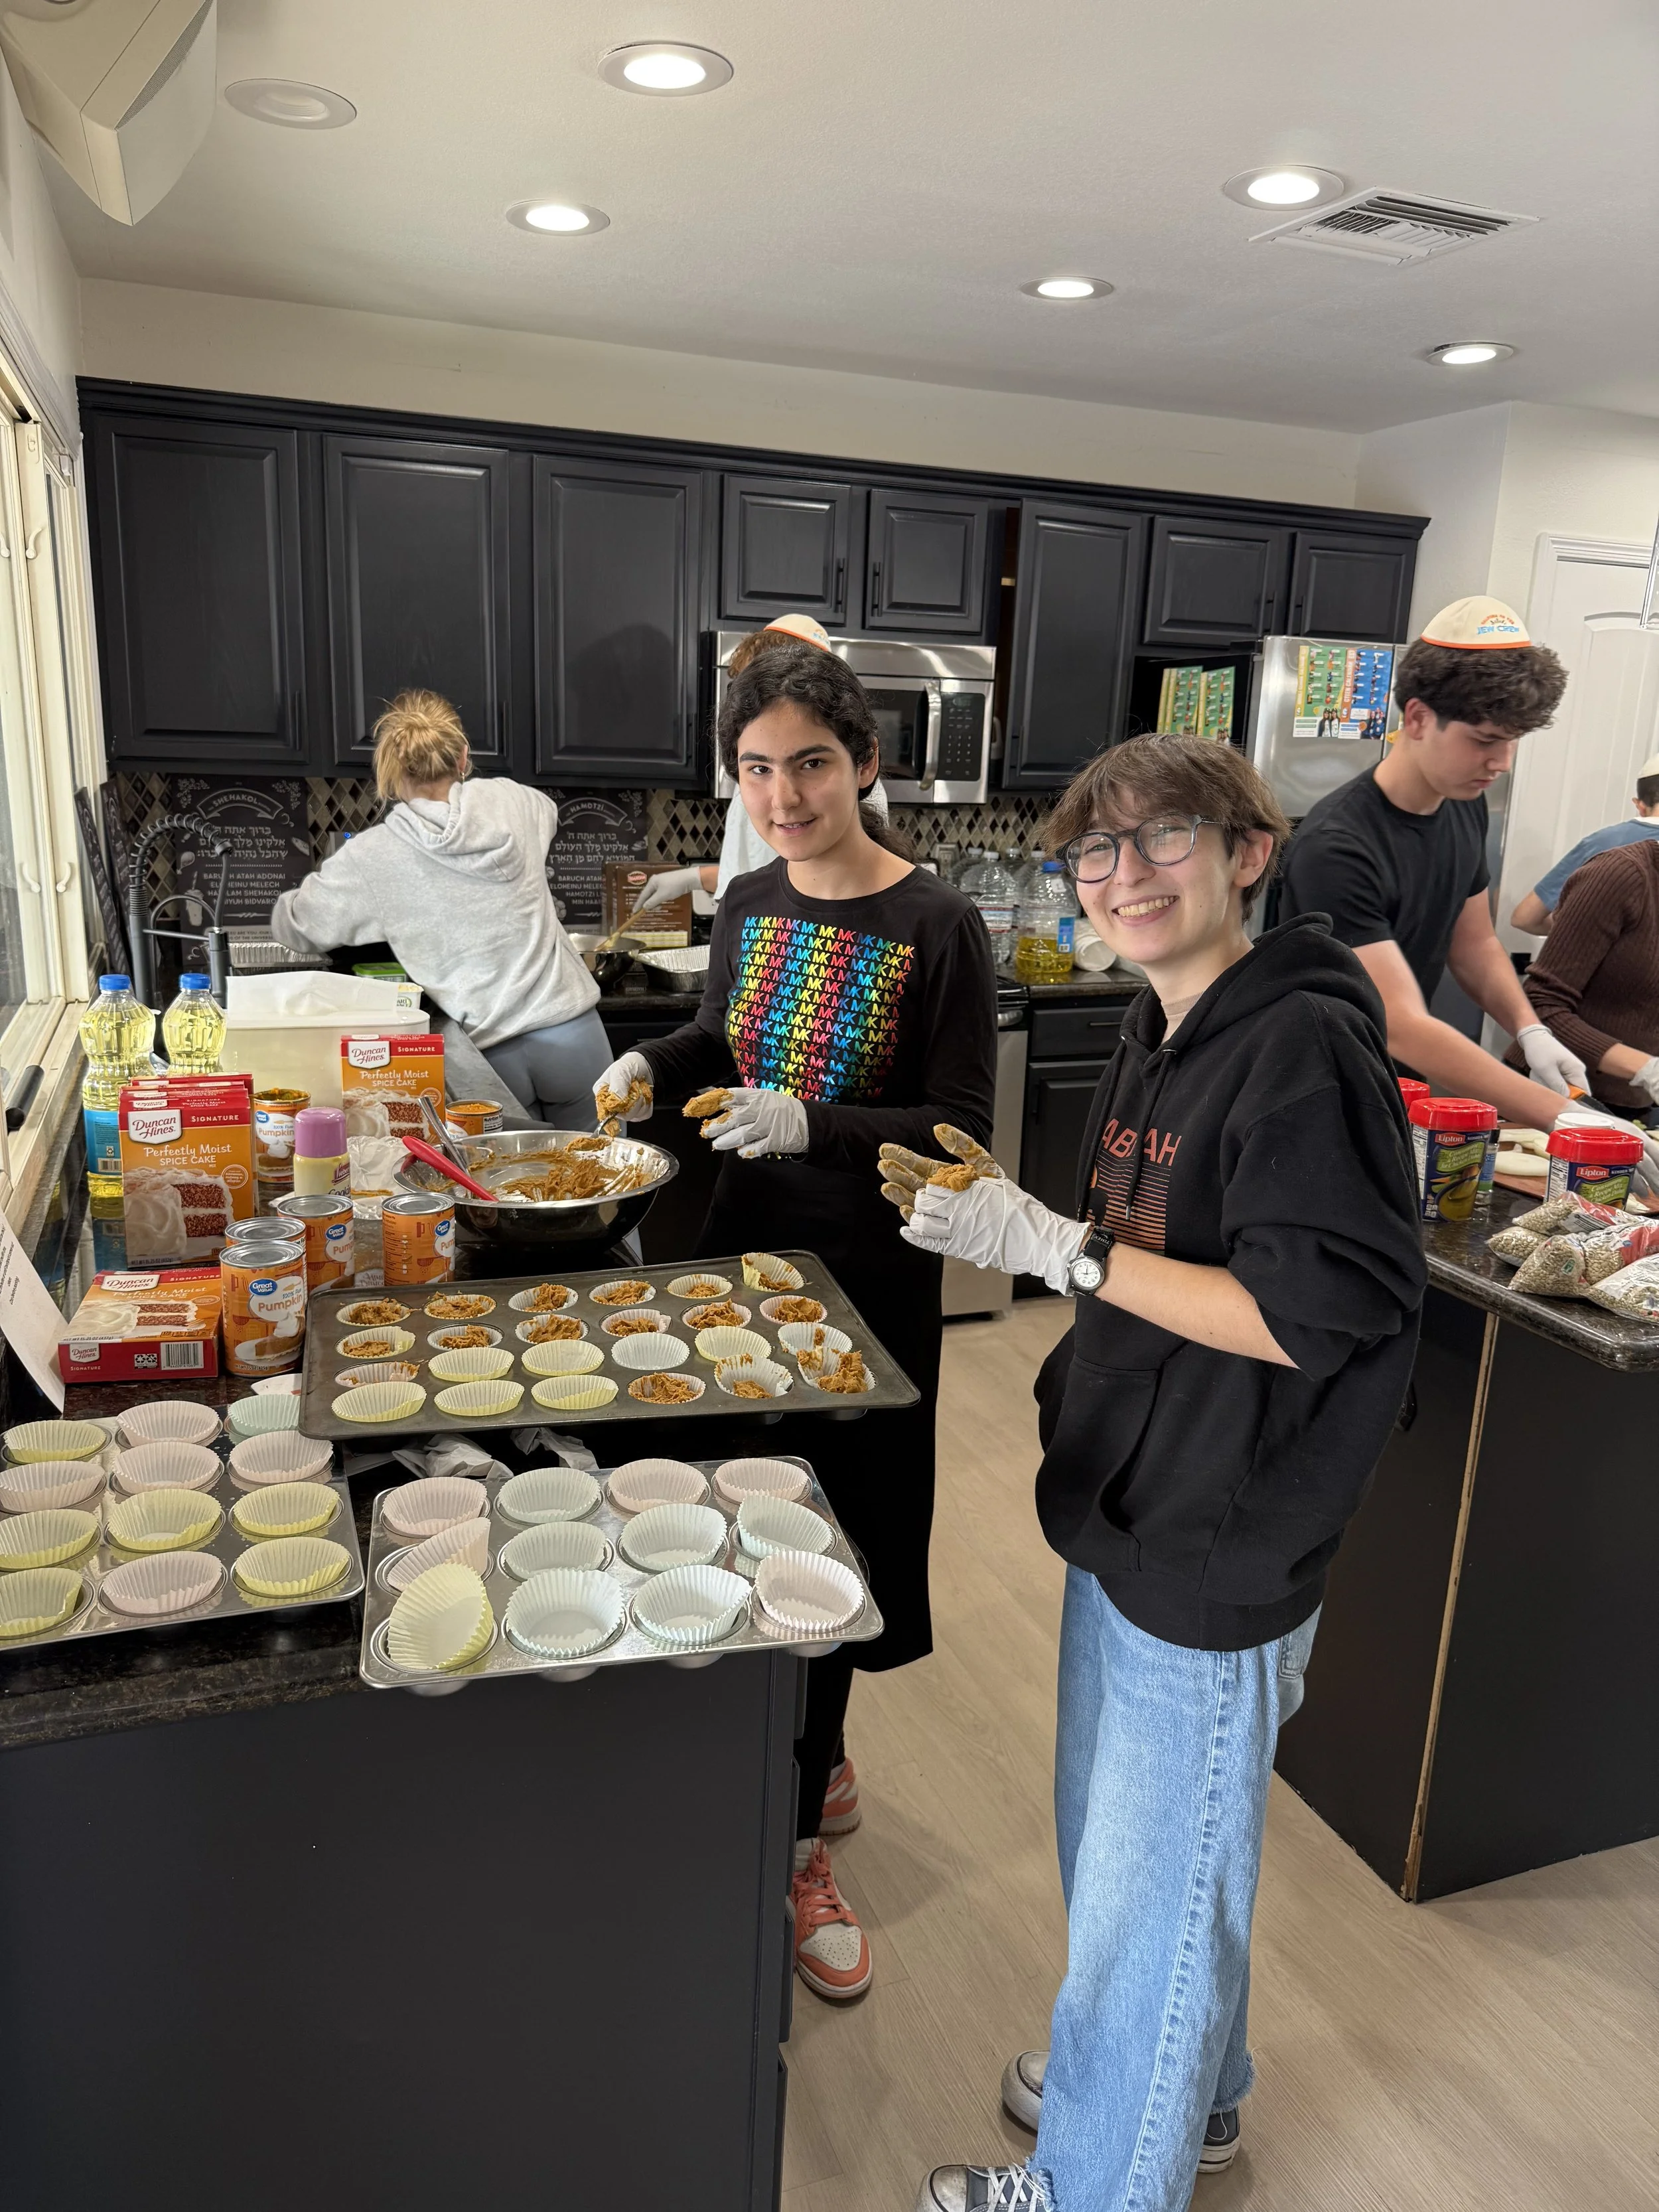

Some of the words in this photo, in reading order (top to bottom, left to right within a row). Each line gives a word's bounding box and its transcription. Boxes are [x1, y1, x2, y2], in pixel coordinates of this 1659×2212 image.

[212, 794, 258, 807] SHEHAKOL
[570, 802, 604, 812] HAMOTZI
[745, 917, 757, 927] MK
[758, 917, 771, 928] MK
[771, 917, 786, 929] MK
[786, 918, 801, 931] MK
[801, 921, 818, 935] MK
[819, 924, 837, 939] MK
[837, 928, 857, 943] MK
[857, 932, 876, 947] MK
[876, 938, 896, 953] MK
[897, 944, 914, 959] MK
[749, 929, 763, 940] MK
[762, 929, 776, 940] MK
[776, 930, 790, 943] MK
[792, 933, 807, 946] MK
[808, 936, 825, 950] MK
[825, 940, 844, 954] MK
[844, 943, 863, 958] MK
[863, 947, 882, 961] MK
[883, 954, 903, 969] MK
[764, 941, 779, 954] MK
[779, 944, 796, 958] MK
[796, 948, 813, 962] MK
[813, 950, 830, 965] MK
[830, 954, 850, 968] MK
[851, 958, 868, 972] MK
[869, 962, 889, 977] MK
[889, 968, 909, 982] MK
[754, 954, 769, 966] MK
[769, 956, 784, 968] MK
[785, 959, 802, 973] MK
[802, 962, 821, 976] MK
[820, 966, 837, 979] MK
[837, 970, 859, 984] MK
[857, 974, 875, 987] MK
[877, 977, 895, 992] MK
[757, 967, 772, 980] MK
[772, 970, 788, 983] MK
[789, 974, 806, 987] MK
[807, 977, 824, 990] MK
[824, 981, 842, 994] MK
[843, 984, 862, 998] MK
[864, 988, 882, 1002] MK
[884, 992, 901, 1005] MK
[761, 980, 778, 994] MK
[778, 984, 794, 997] MK
[796, 988, 813, 1001] MK
[813, 992, 832, 1005] MK
[831, 995, 851, 1009] MK
[352, 1047, 386, 1058] Duncan
[357, 1055, 384, 1065] Hines
[360, 1070, 401, 1080] Perfectly
[403, 1070, 429, 1078] Moist
[132, 1116, 176, 1131] Duncan
[139, 1126, 175, 1139] Hines
[259, 1128, 295, 1138] Pumpkin
[1438, 1134, 1463, 1143] Lipton
[1102, 1118, 1182, 1166] ABAH
[143, 1145, 196, 1157] Perfectly
[200, 1143, 232, 1154] Moist
[160, 1157, 188, 1166] SPICE
[190, 1155, 216, 1164] CAKE
[1580, 1168, 1607, 1177] Lipton
[106, 1278, 154, 1288] Duncan
[258, 1294, 303, 1312] Pumpkin
[72, 1347, 97, 1356] Duncan
